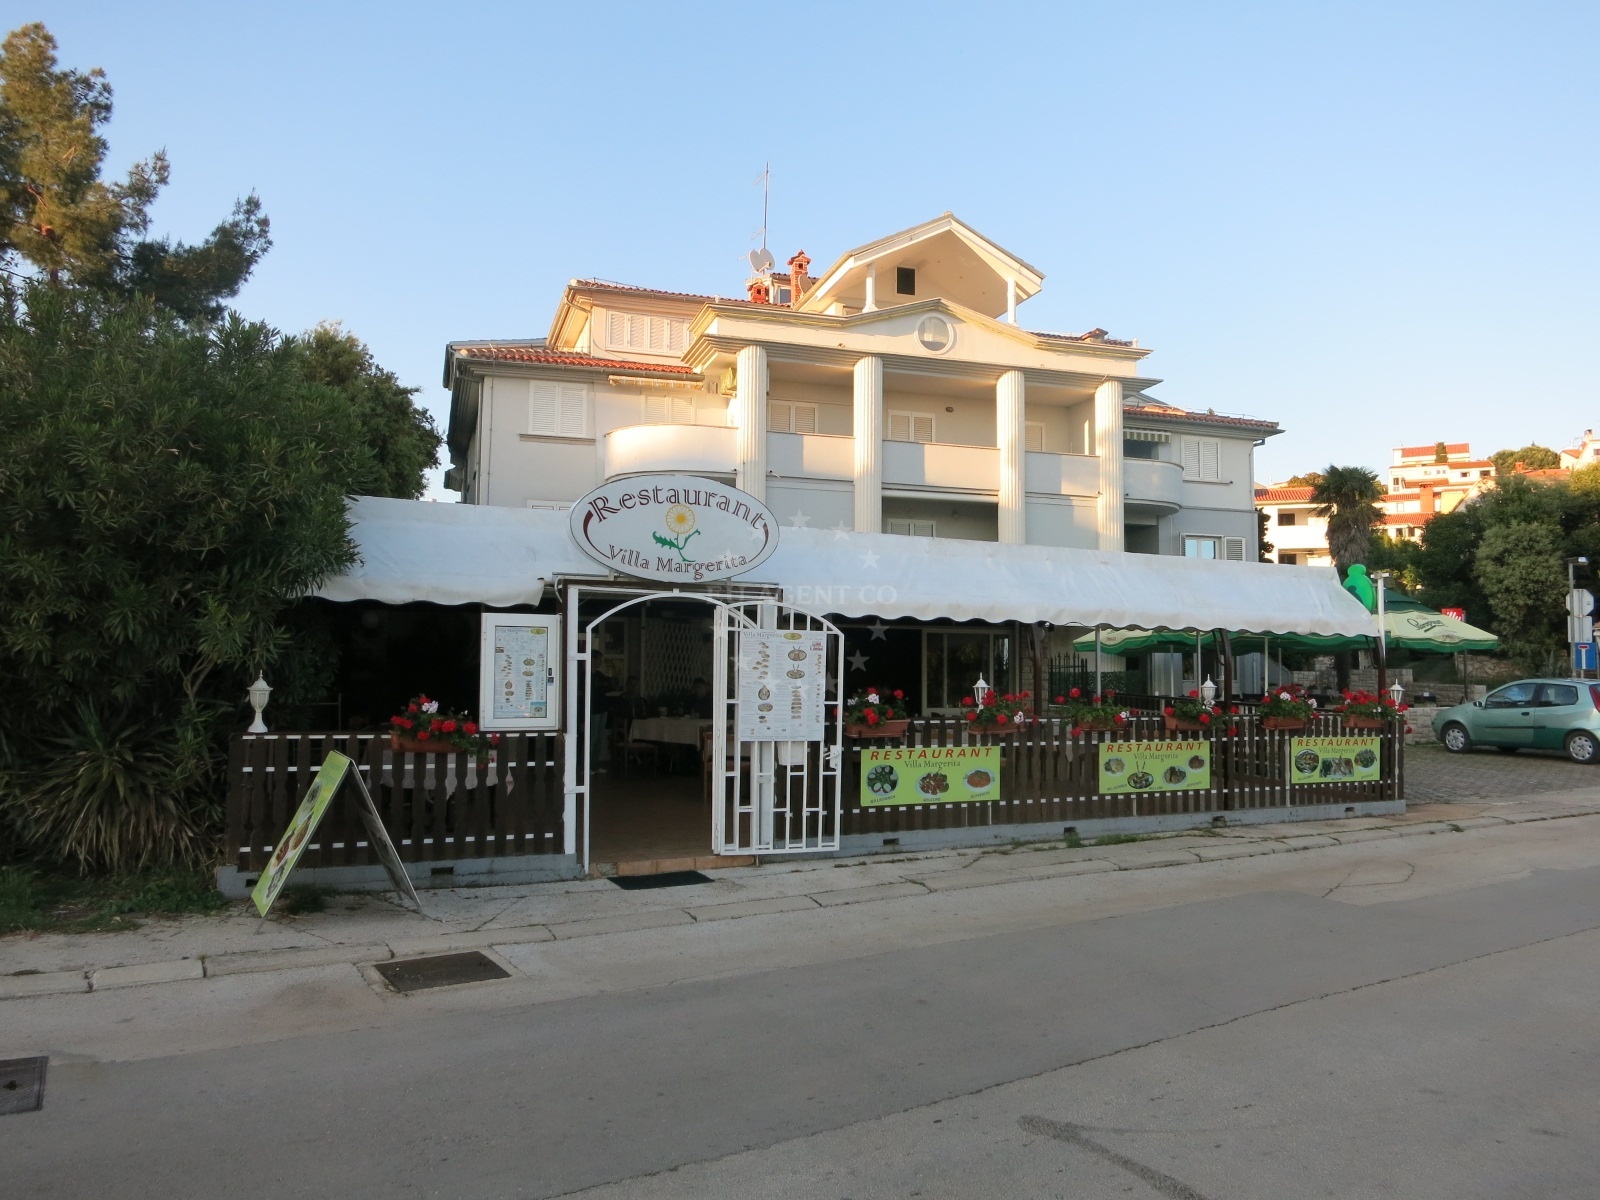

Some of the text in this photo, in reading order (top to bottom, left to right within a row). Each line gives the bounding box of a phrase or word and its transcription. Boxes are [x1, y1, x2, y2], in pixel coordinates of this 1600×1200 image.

[588, 485, 767, 530] Restaurant
[609, 544, 748, 581] Villa Margerita
[1106, 742, 1203, 753] RESTAURANT
[1297, 738, 1376, 747] RESTAURANT
[870, 747, 992, 761] RESTAURANT
[1134, 752, 1178, 763] Villa Margerita
[904, 760, 961, 770] Villa Margerita
